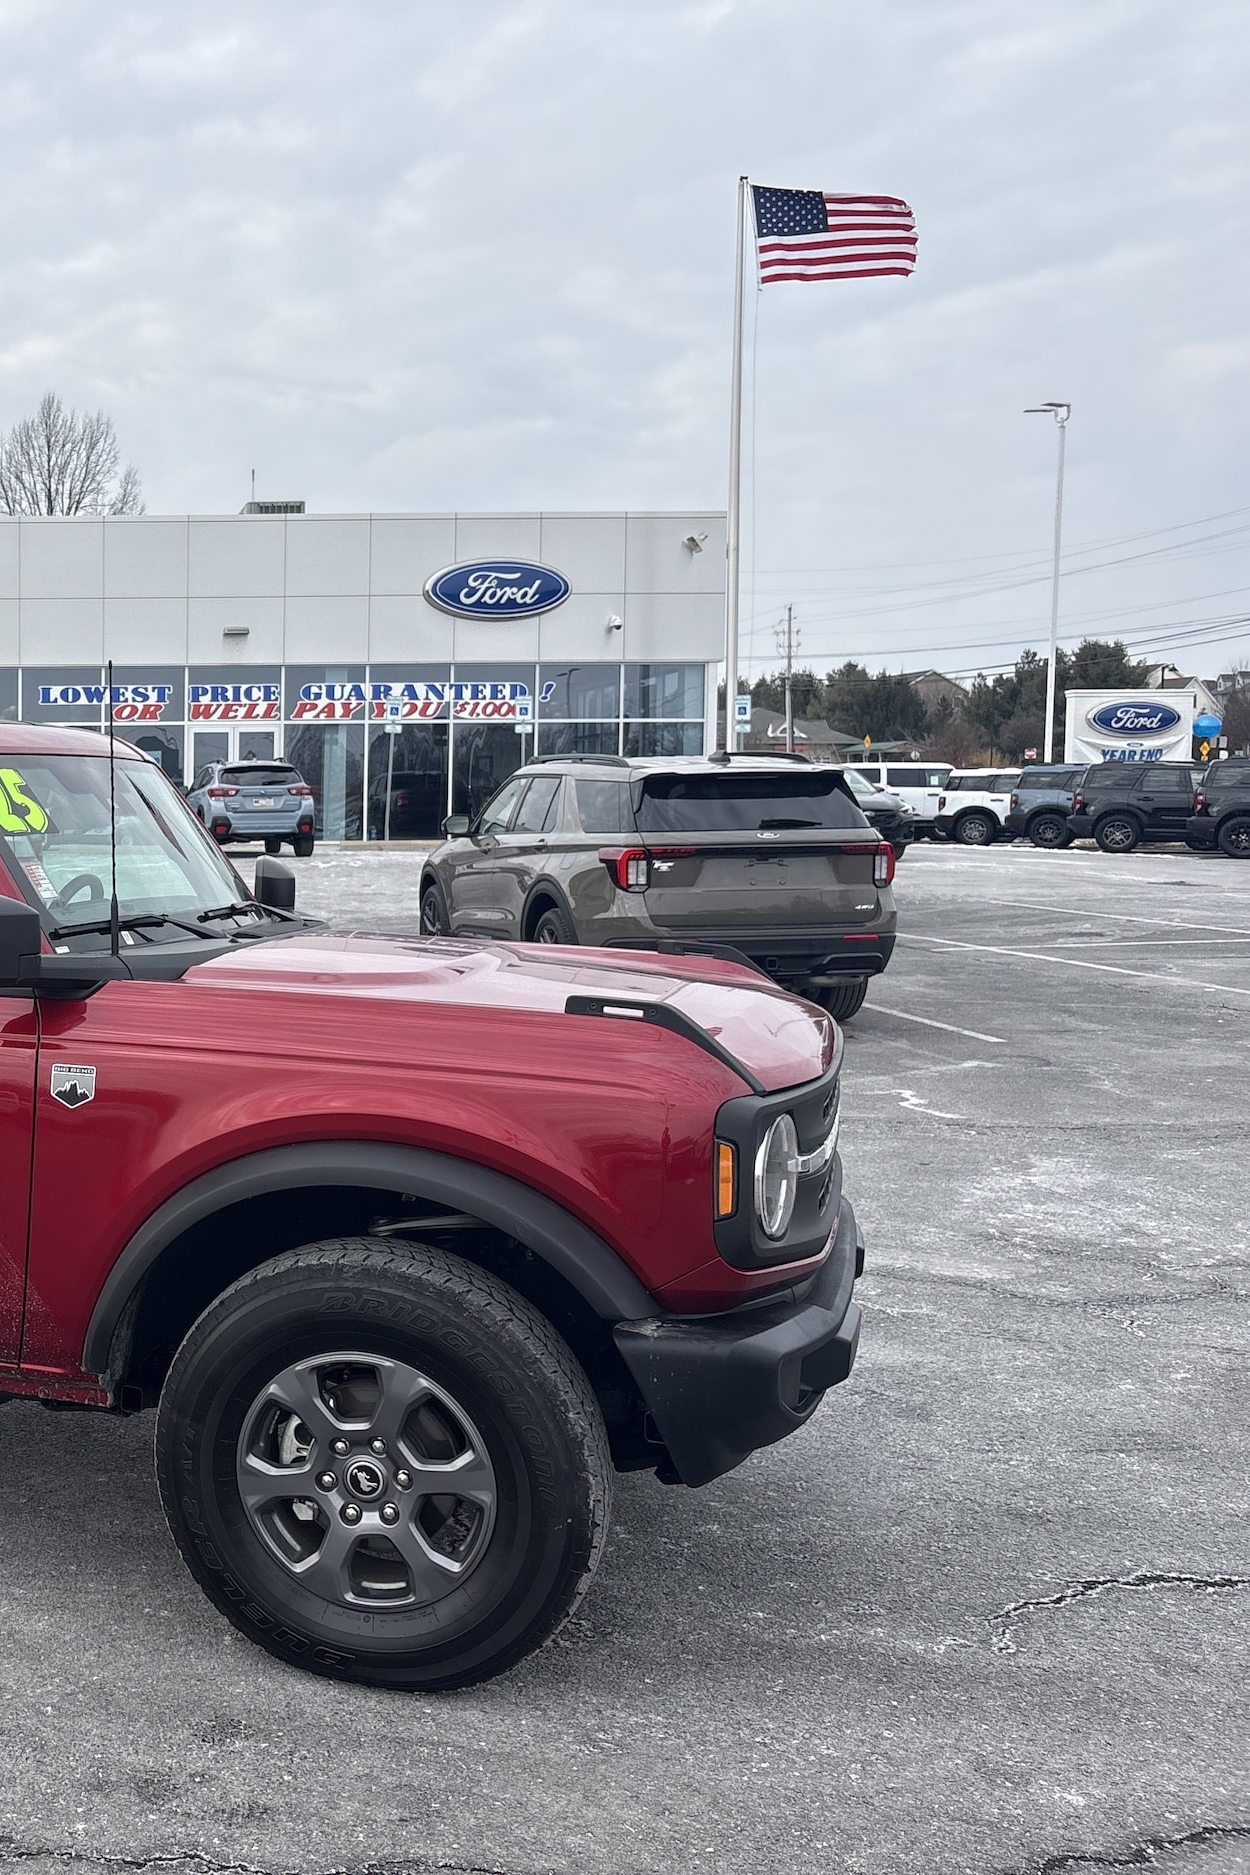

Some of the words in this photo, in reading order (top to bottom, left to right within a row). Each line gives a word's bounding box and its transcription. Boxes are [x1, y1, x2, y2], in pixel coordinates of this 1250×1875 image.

[459, 571, 542, 605] Ford
[39, 686, 171, 703] LOWEST
[189, 685, 279, 702] PRICE
[301, 683, 528, 700] GUARANTEED
[114, 704, 164, 720] OR
[190, 703, 279, 719] WE'LL
[291, 702, 363, 718] PAY
[453, 701, 516, 718] $1,00
[1110, 707, 1163, 729] Ford
[1101, 748, 1137, 761] YEAR
[1139, 748, 1163, 761] END
